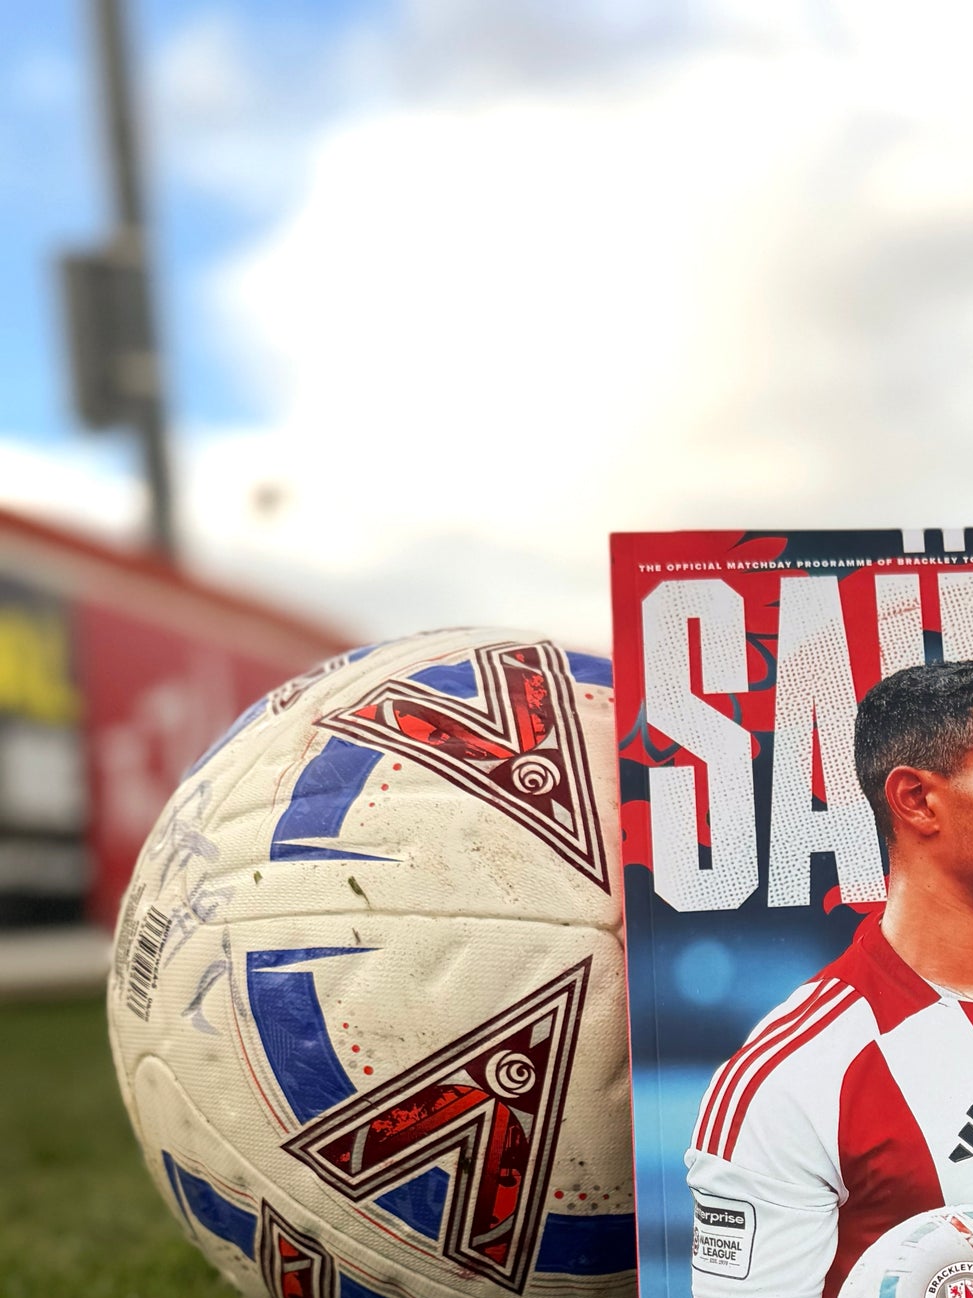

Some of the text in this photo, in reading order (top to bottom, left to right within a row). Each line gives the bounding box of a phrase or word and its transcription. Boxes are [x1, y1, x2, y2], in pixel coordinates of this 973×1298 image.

[639, 564, 662, 573] THE
[666, 562, 722, 572] OFFICIAL
[727, 561, 792, 570] MATCHDAY
[797, 559, 872, 569] PROGRAMME
[877, 558, 893, 567] OF
[897, 556, 958, 566] BRACKLEY
[695, 1206, 745, 1224] erprise
[700, 1236, 742, 1251] NATIONAL
[702, 1246, 736, 1261] LEAGUE
[928, 1264, 973, 1294] BRACKLEY
